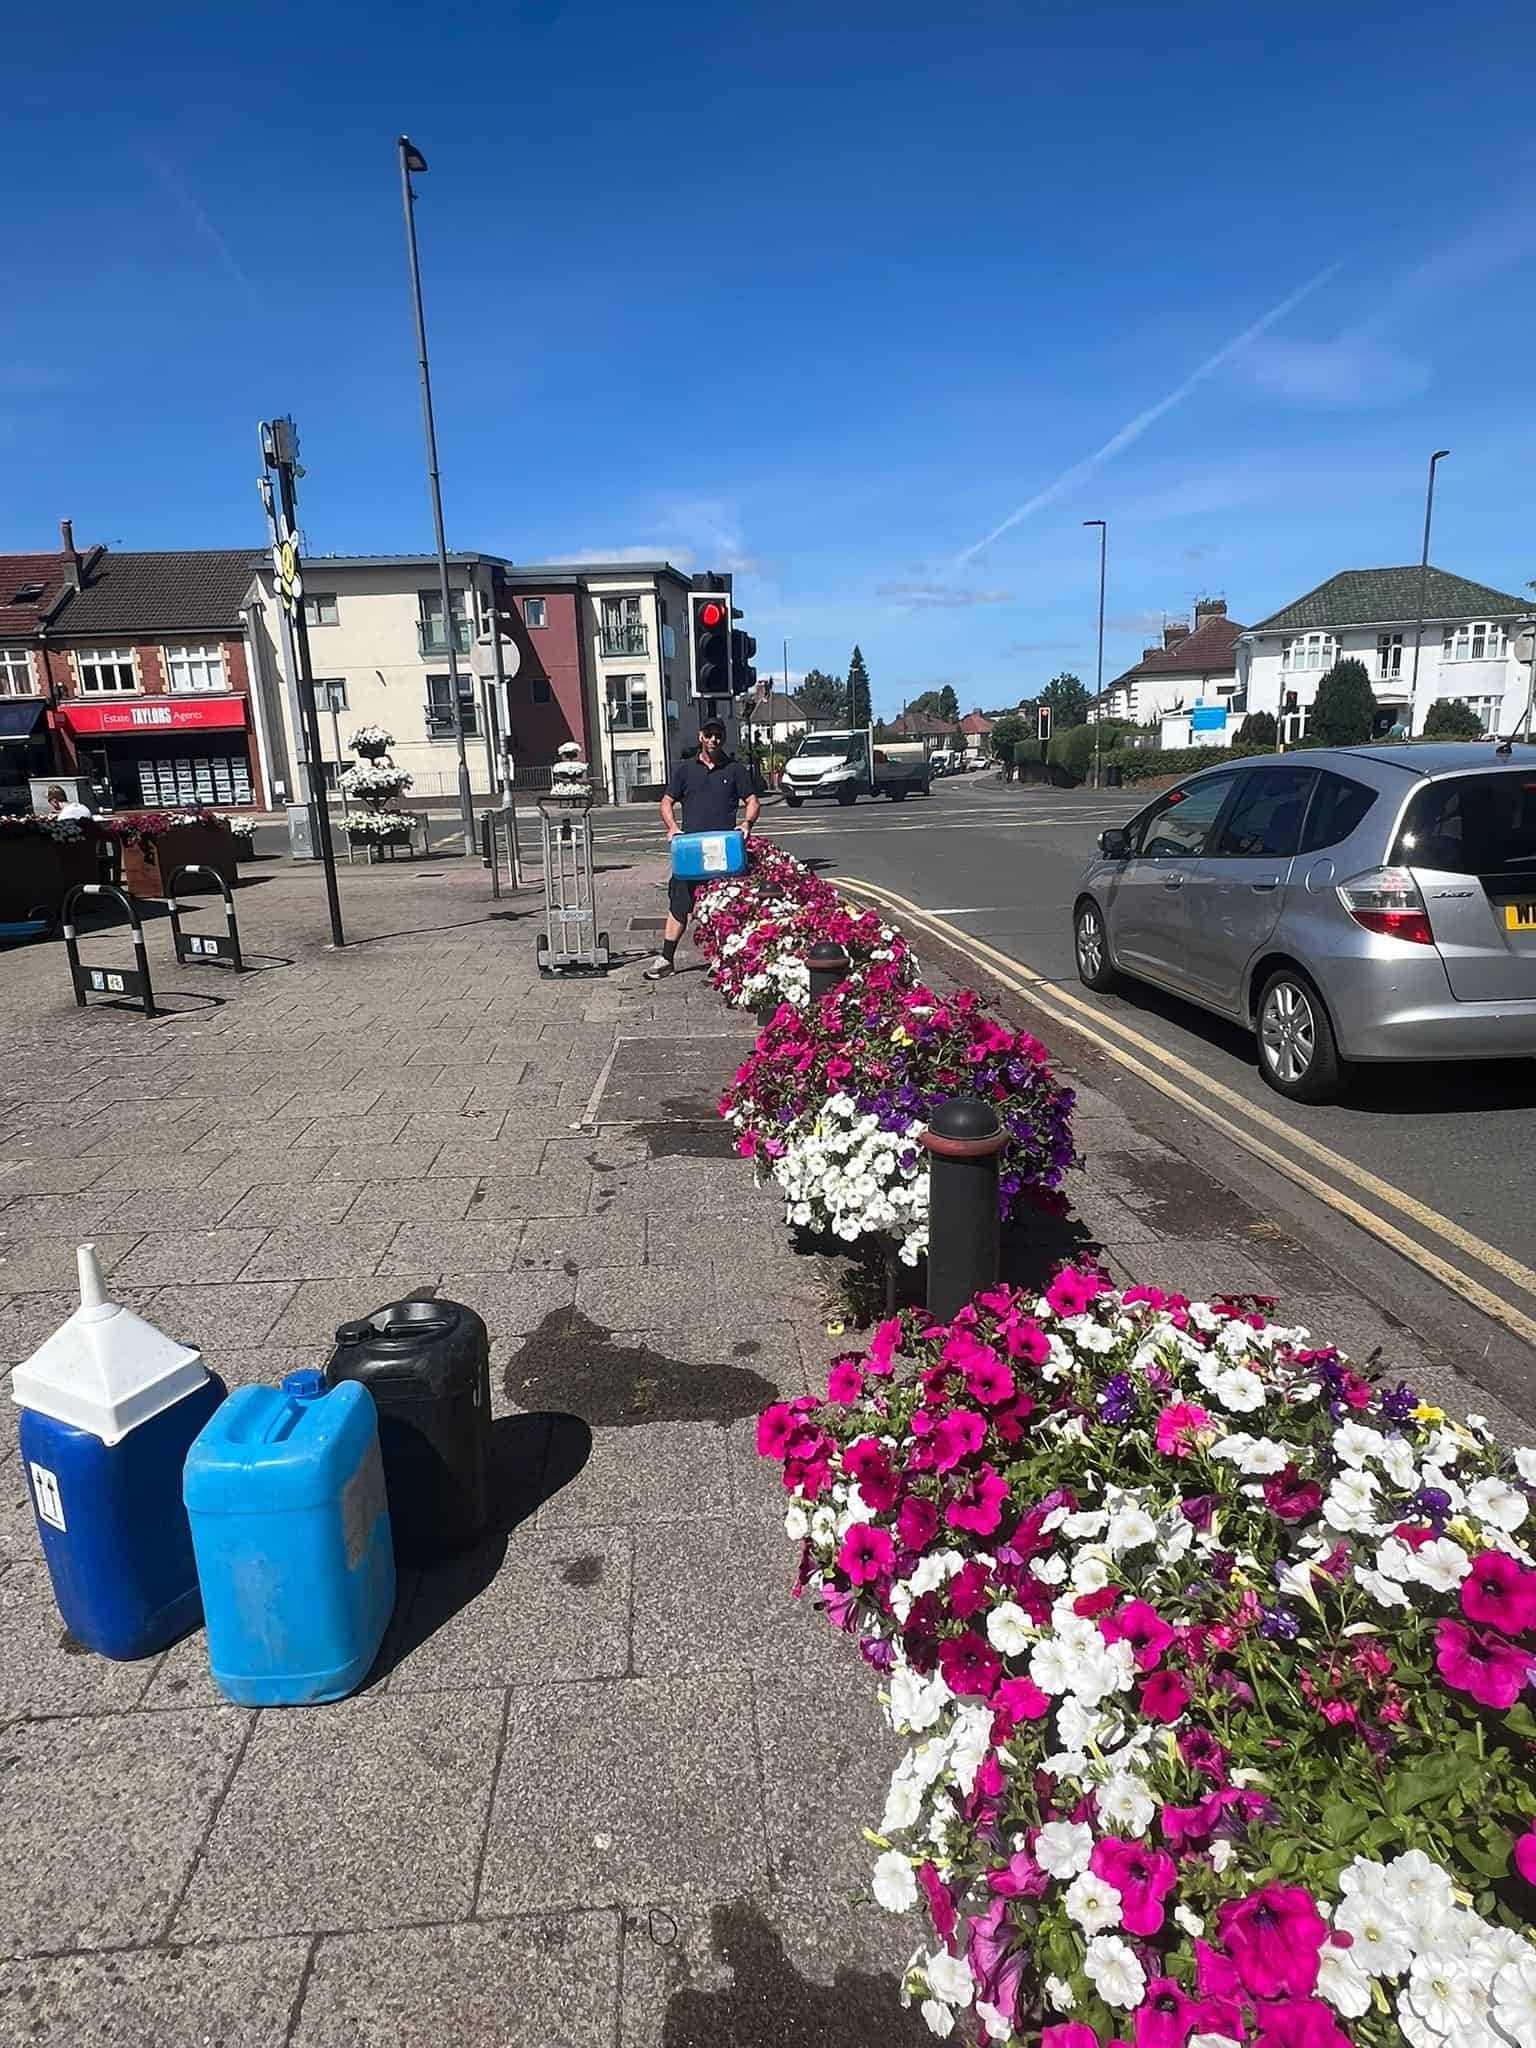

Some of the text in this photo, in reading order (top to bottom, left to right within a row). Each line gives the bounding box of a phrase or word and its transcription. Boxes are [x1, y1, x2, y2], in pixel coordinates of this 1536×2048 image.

[103, 707, 203, 725] Estate TAYLORS Agents
